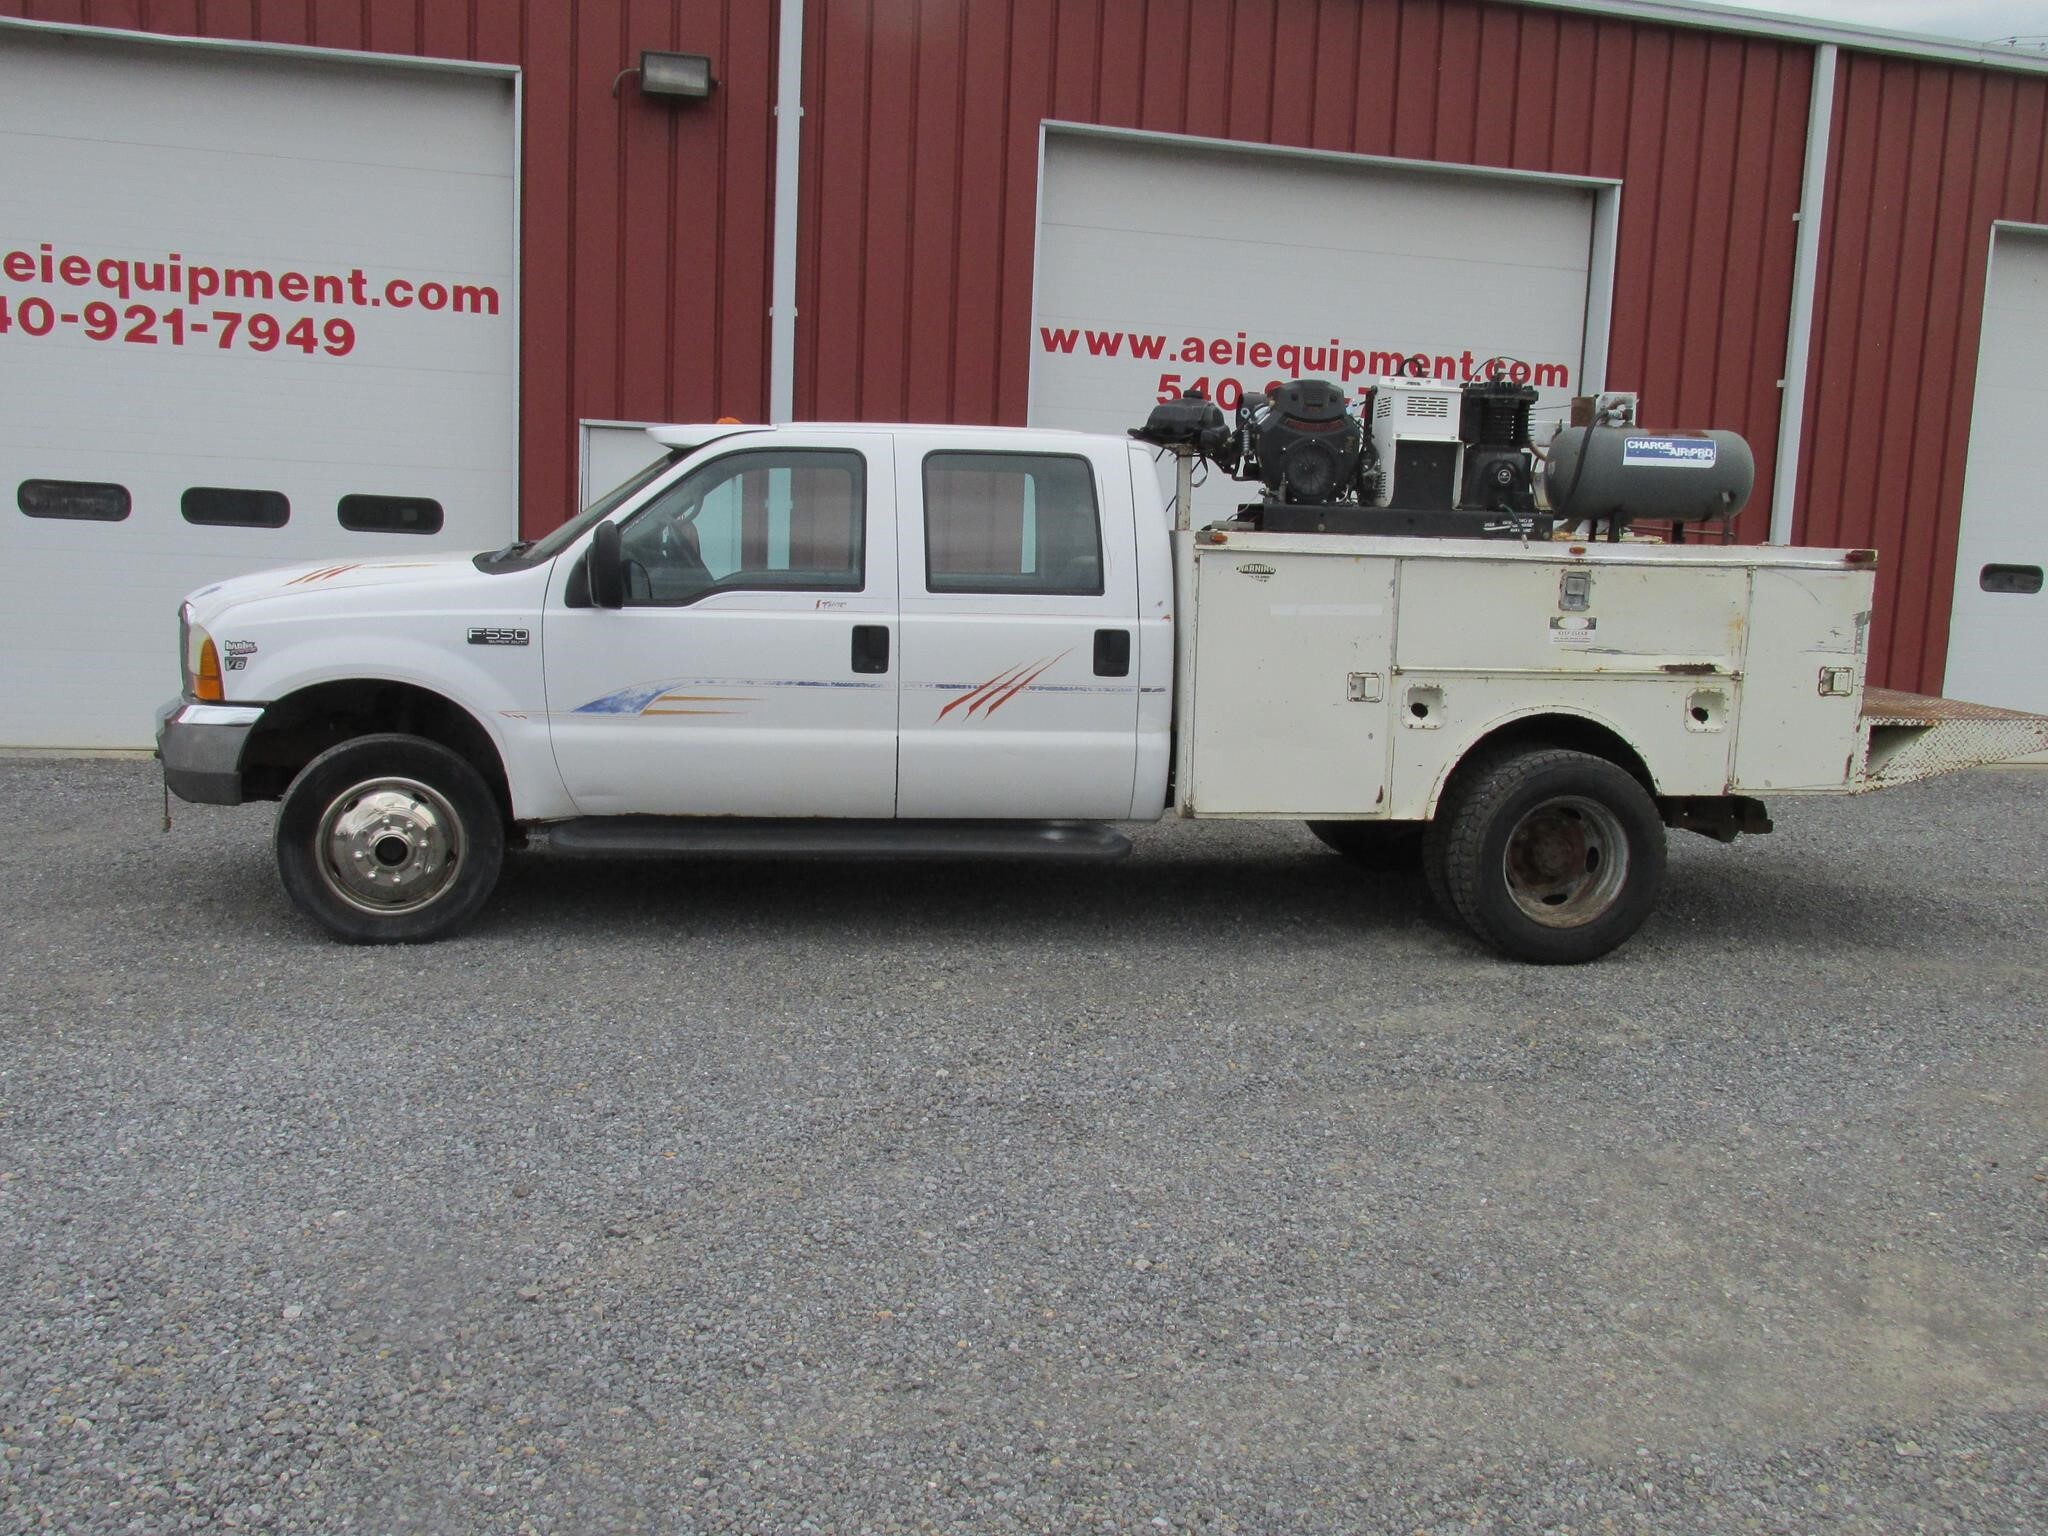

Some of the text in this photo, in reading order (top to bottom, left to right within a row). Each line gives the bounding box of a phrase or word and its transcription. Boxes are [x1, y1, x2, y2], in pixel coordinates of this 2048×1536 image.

[3, 244, 499, 315] eiequipment.com
[1040, 328, 1569, 388] www.aeiequipment.com
[1627, 440, 1673, 450] CHARGE
